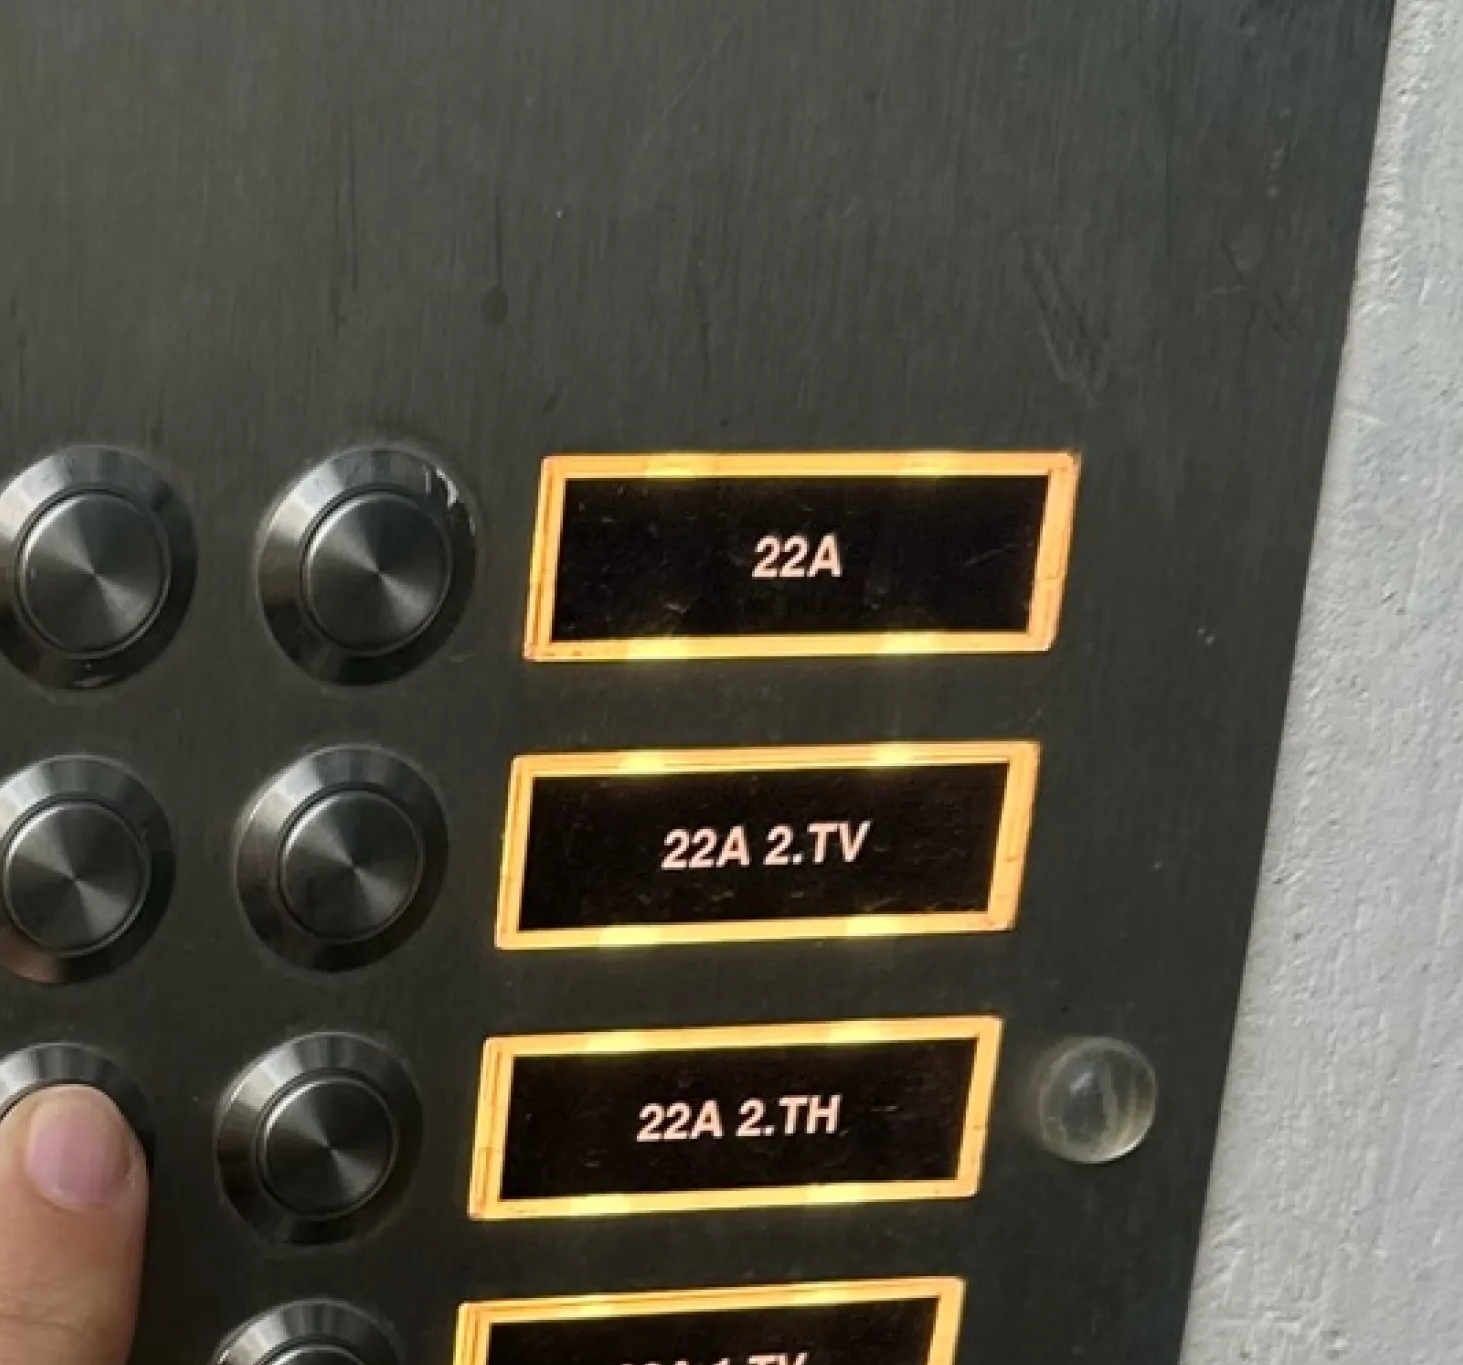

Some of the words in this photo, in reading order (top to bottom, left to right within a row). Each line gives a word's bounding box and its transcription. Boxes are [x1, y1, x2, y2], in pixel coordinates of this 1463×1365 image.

[751, 534, 841, 578] 22A
[660, 825, 750, 871] 22A
[762, 820, 871, 866] 2.TV
[636, 1099, 723, 1143] 22A
[735, 1094, 841, 1137] 2.TH
